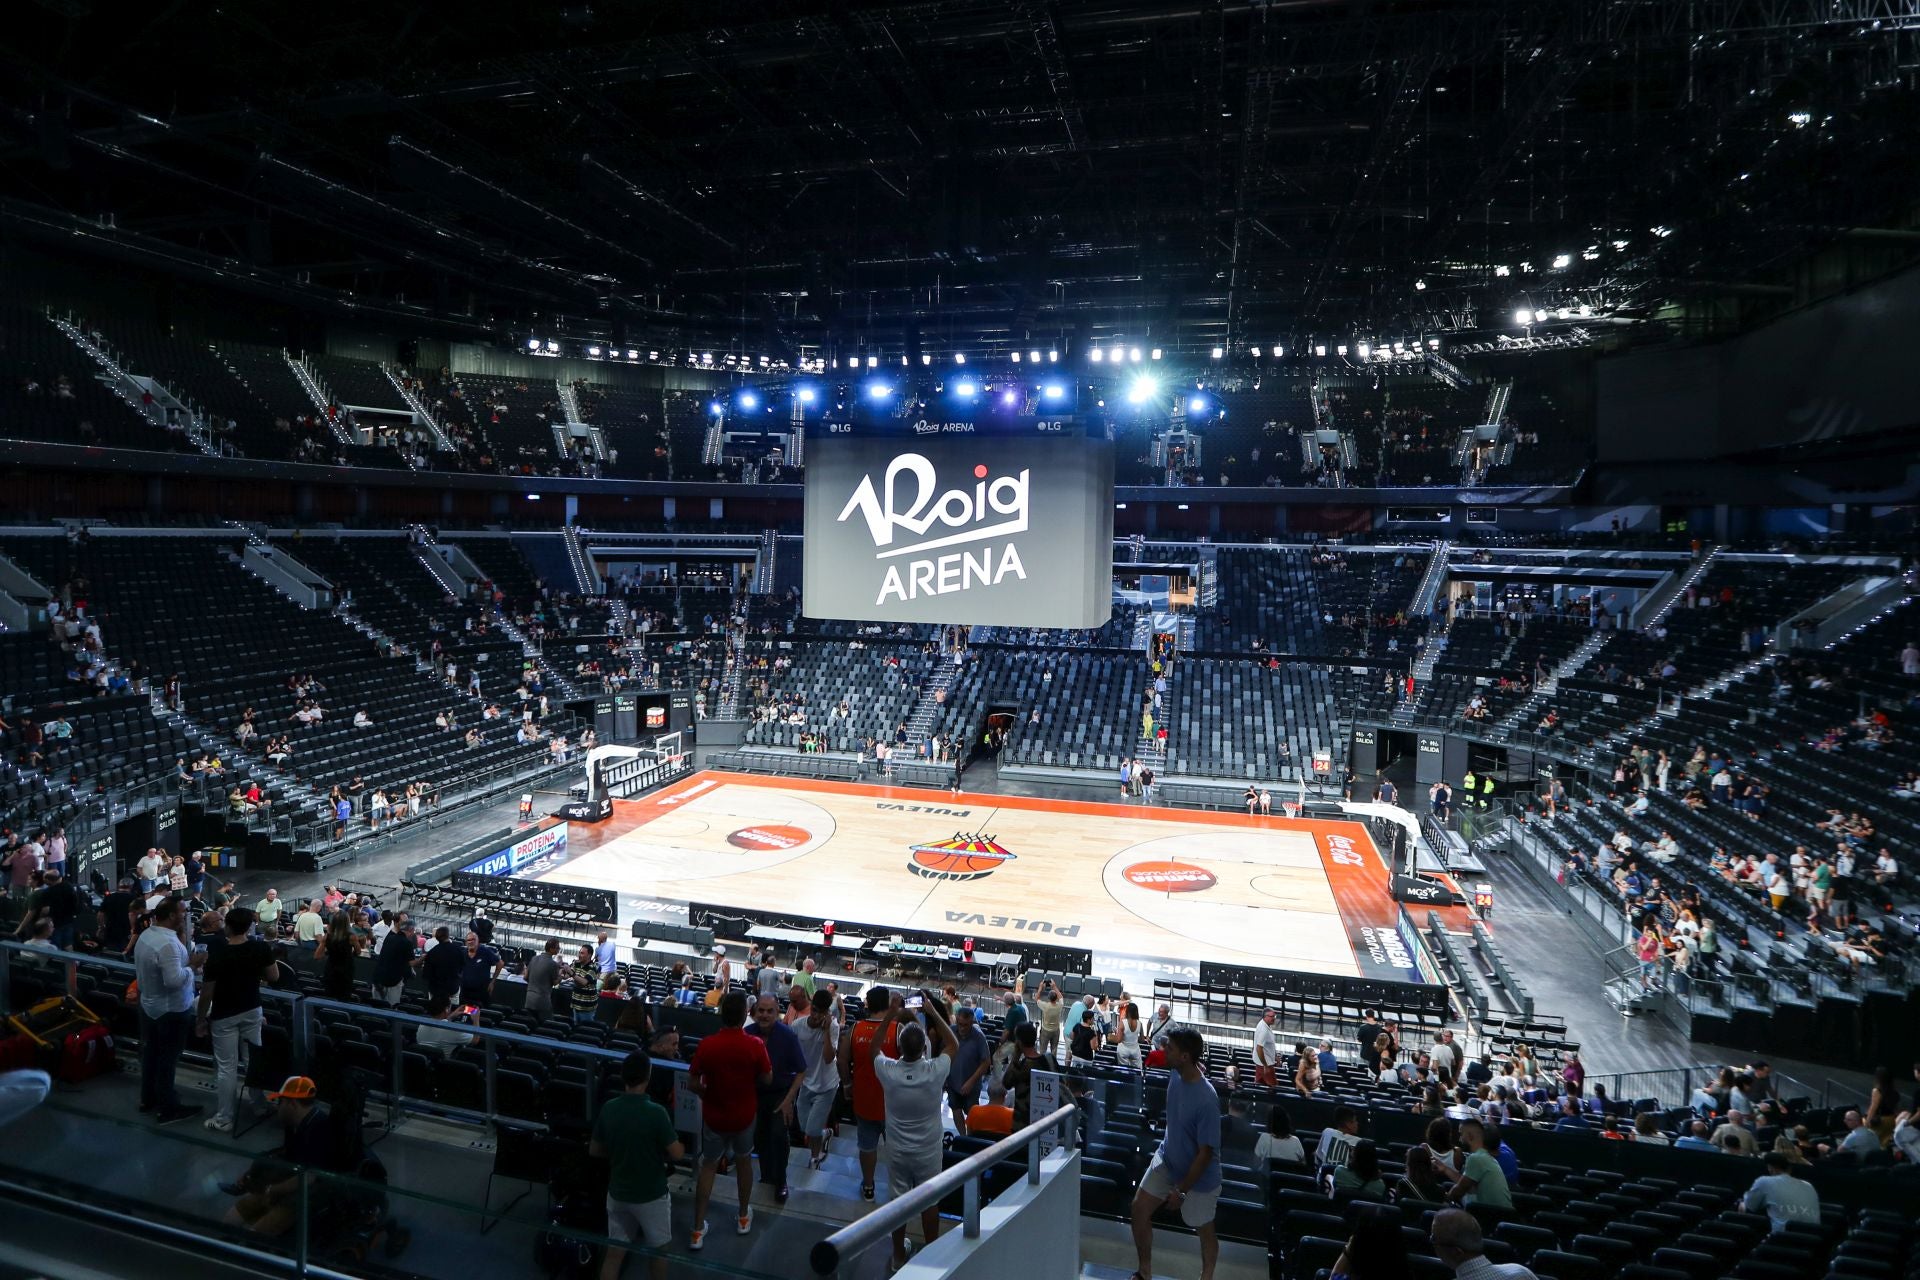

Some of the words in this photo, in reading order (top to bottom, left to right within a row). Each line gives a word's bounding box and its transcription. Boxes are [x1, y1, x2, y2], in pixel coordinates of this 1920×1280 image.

[839, 424, 851, 432] LG
[943, 423, 975, 432] ARENA
[1048, 421, 1060, 430] LG
[837, 453, 1030, 558] Roig
[875, 542, 1027, 606] ARENA
[1356, 737, 1374, 745] SALIDA
[1420, 745, 1439, 753] SALIDA
[1316, 761, 1329, 771] 24
[876, 803, 972, 817] PULEVA
[159, 817, 177, 830] SALIDA
[91, 845, 113, 861] SALIDA
[1407, 887, 1428, 897] MGS
[1477, 895, 1492, 905] 24
[945, 910, 1081, 937] PULEVA
[964, 941, 972, 951] 0
[1037, 1082, 1052, 1093] 114
